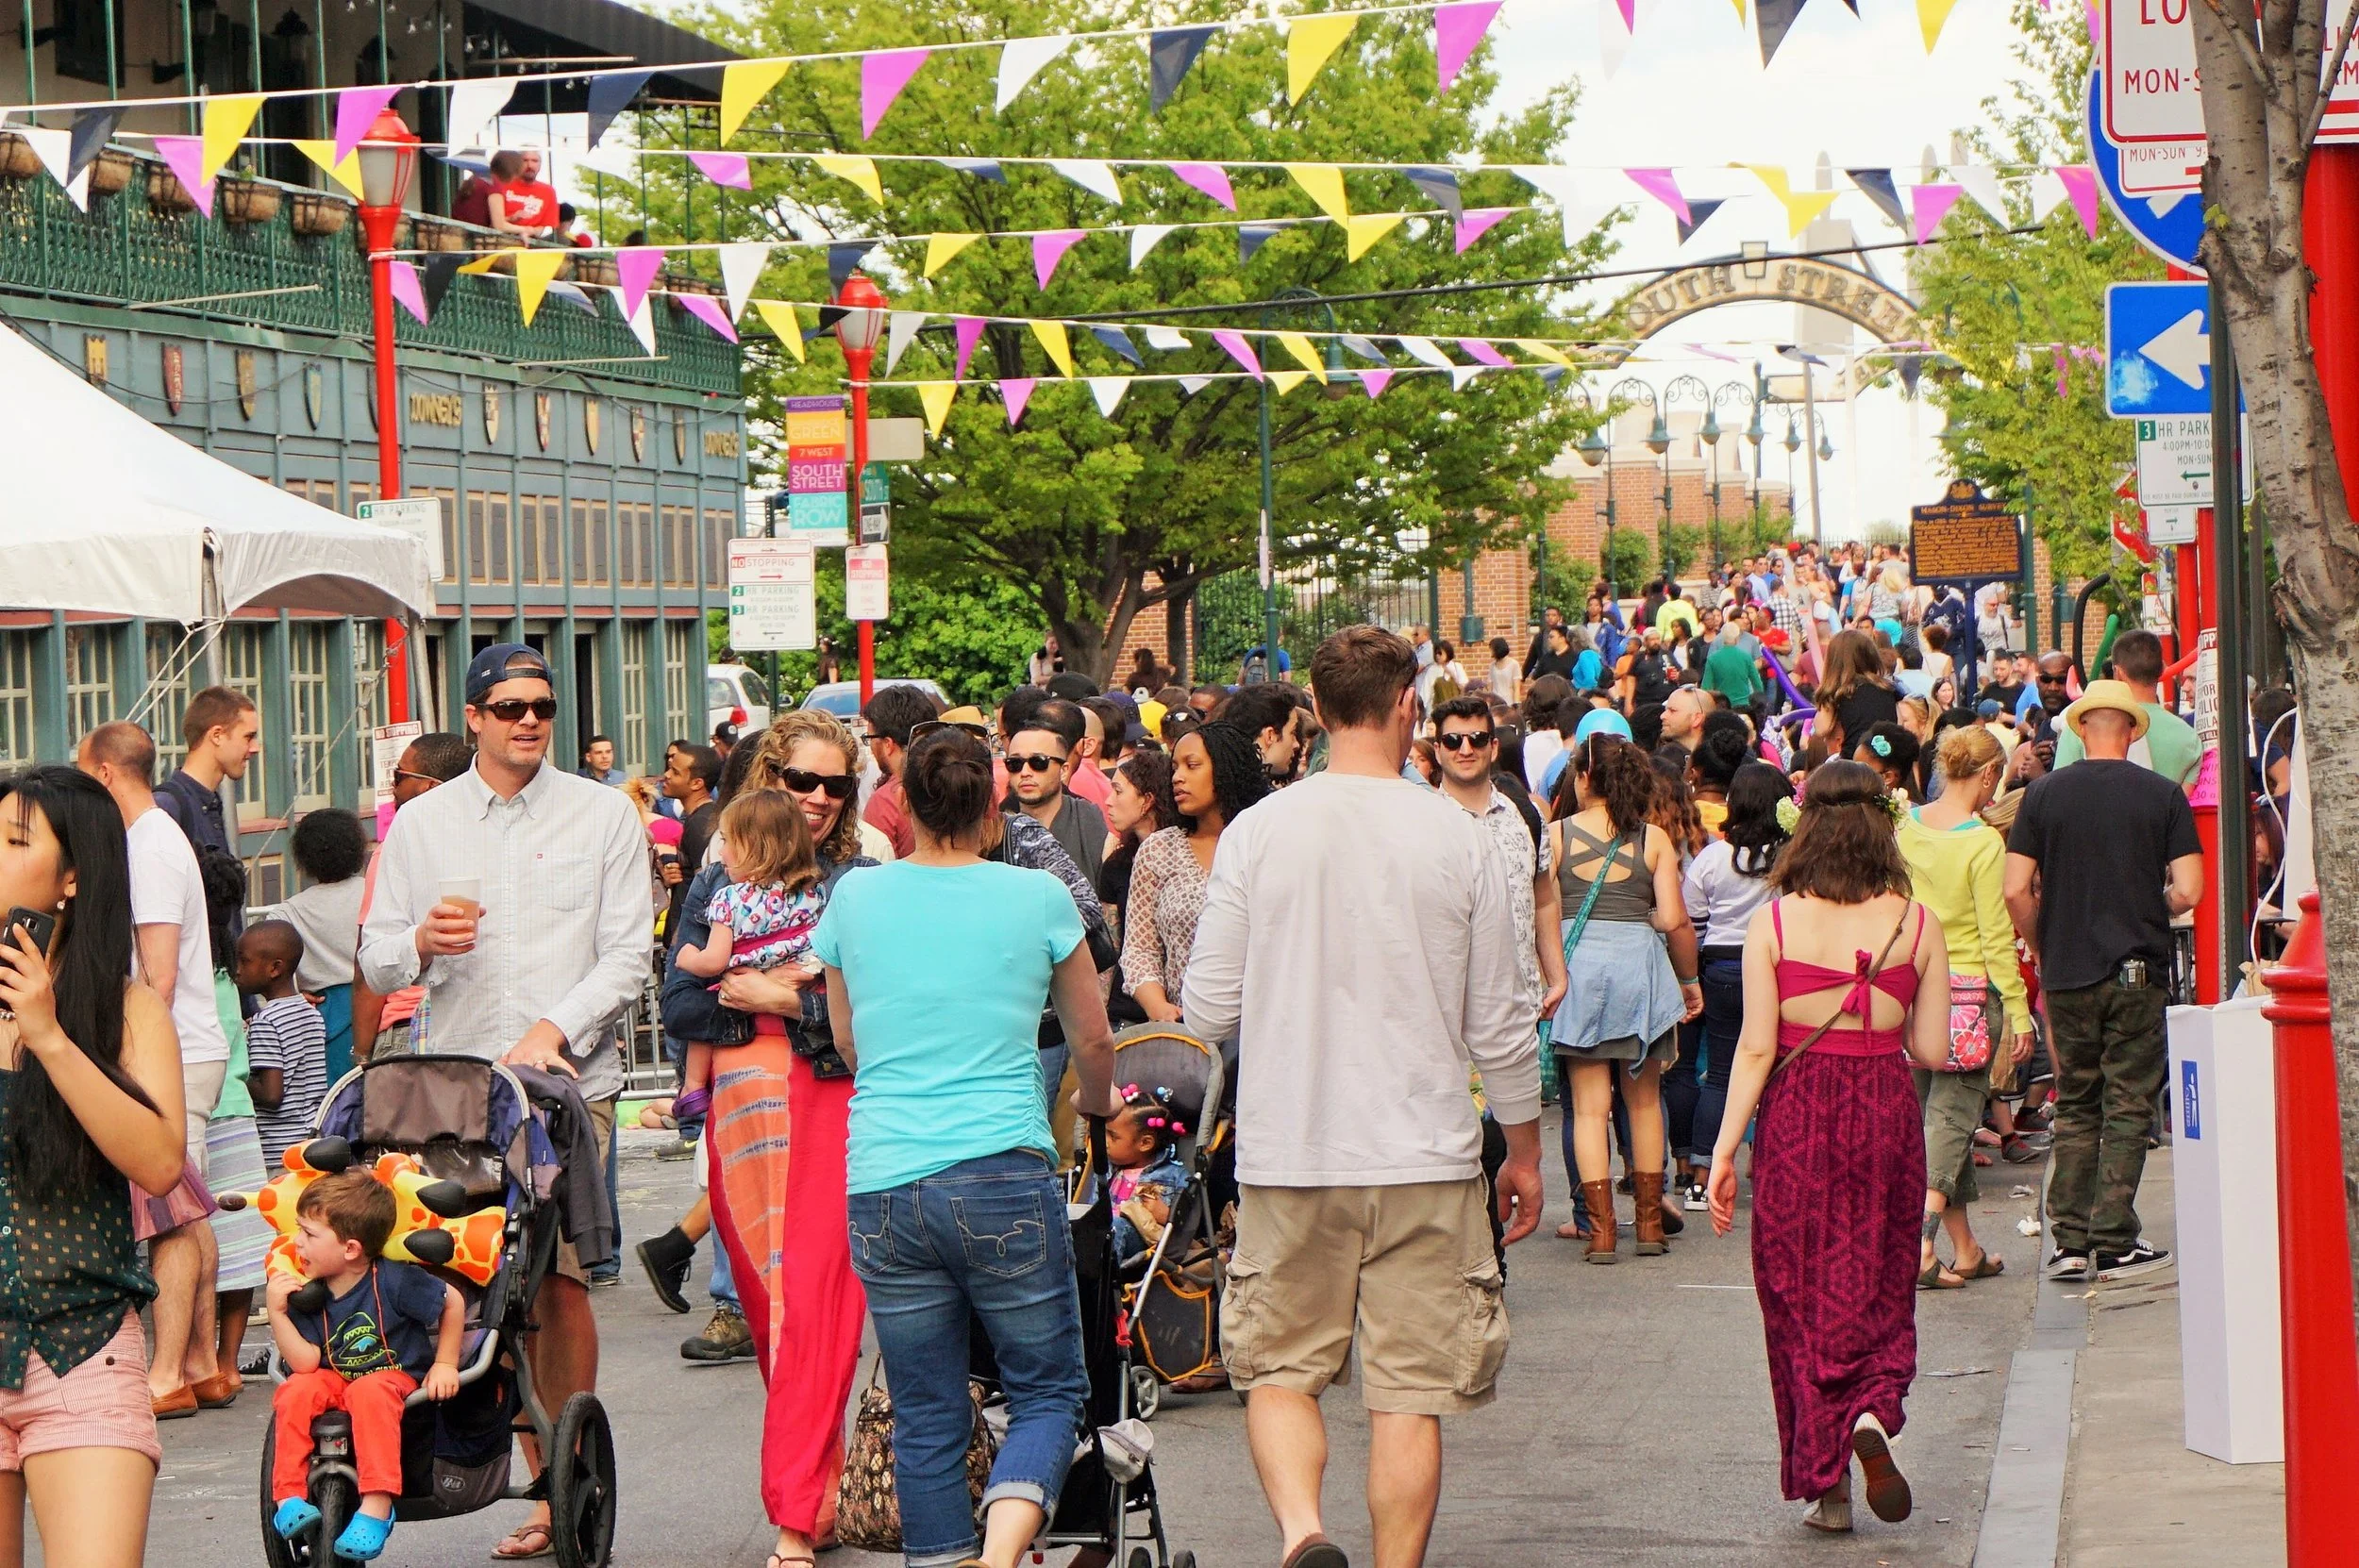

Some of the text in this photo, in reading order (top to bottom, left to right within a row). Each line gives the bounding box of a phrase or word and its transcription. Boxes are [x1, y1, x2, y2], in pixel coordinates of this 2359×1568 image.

[792, 425, 841, 440] GREEN
[2144, 420, 2210, 440] 3 HR PARK
[798, 446, 834, 458] 7 WEST
[2162, 440, 2210, 452] 4:00PM-10:0
[792, 463, 844, 477] SOUTH
[792, 475, 843, 490] STREET
[795, 494, 843, 509] FABRIC
[362, 506, 370, 518] 2
[795, 509, 844, 525] ROW
[732, 558, 795, 568] NO STOPPING
[735, 587, 742, 596] 2
[761, 586, 800, 595] PARKING
[735, 606, 743, 615] 3
[761, 605, 800, 614] PARKING
